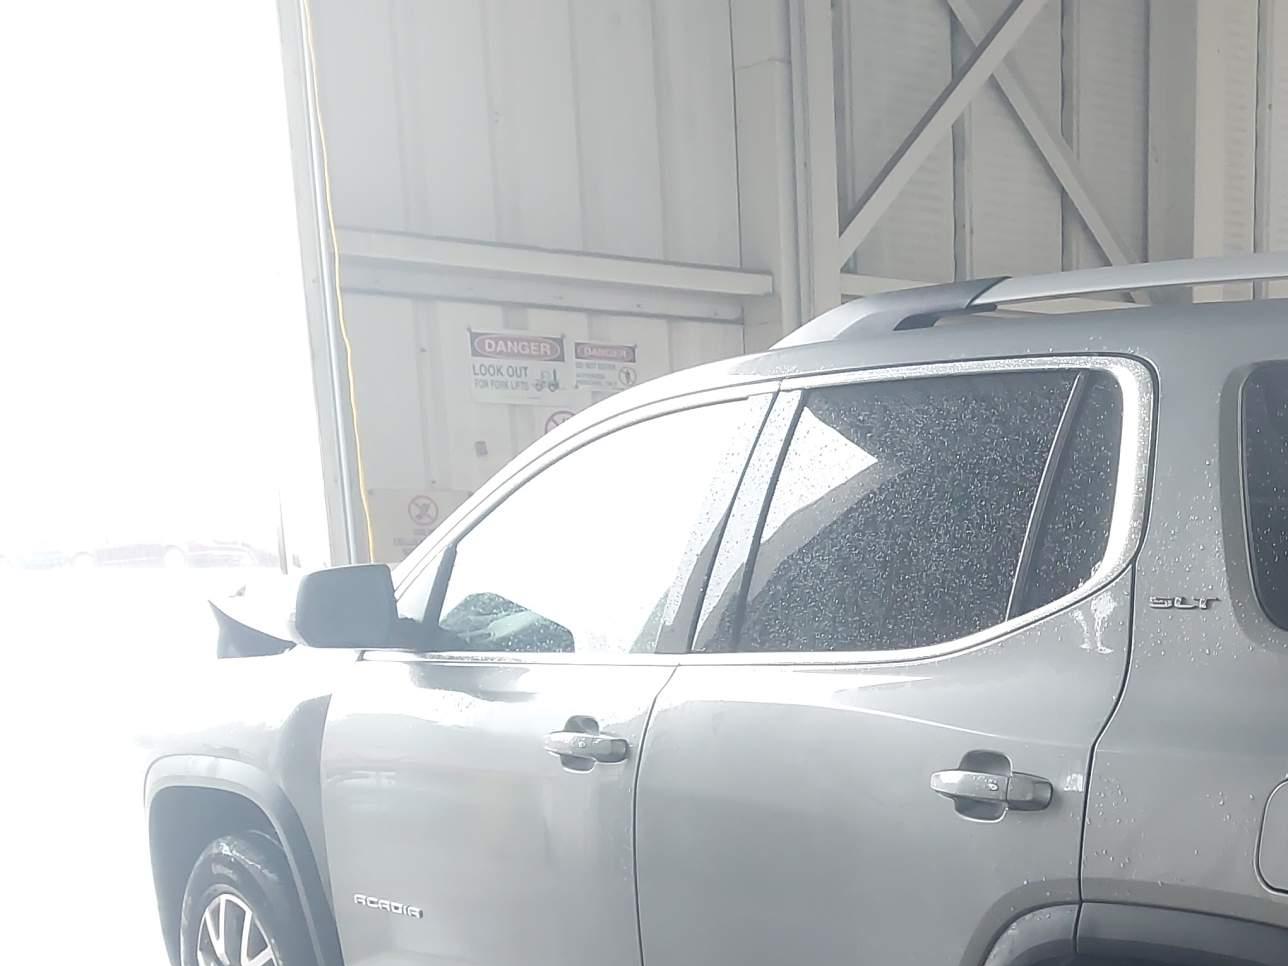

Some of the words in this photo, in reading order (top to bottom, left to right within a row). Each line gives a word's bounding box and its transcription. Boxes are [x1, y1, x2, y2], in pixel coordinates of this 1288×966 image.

[484, 339, 551, 356] DANGER
[472, 363, 504, 377] LOOK
[506, 365, 529, 378] OUT
[1149, 596, 1220, 610] SLT
[354, 894, 422, 919] ACADIA
